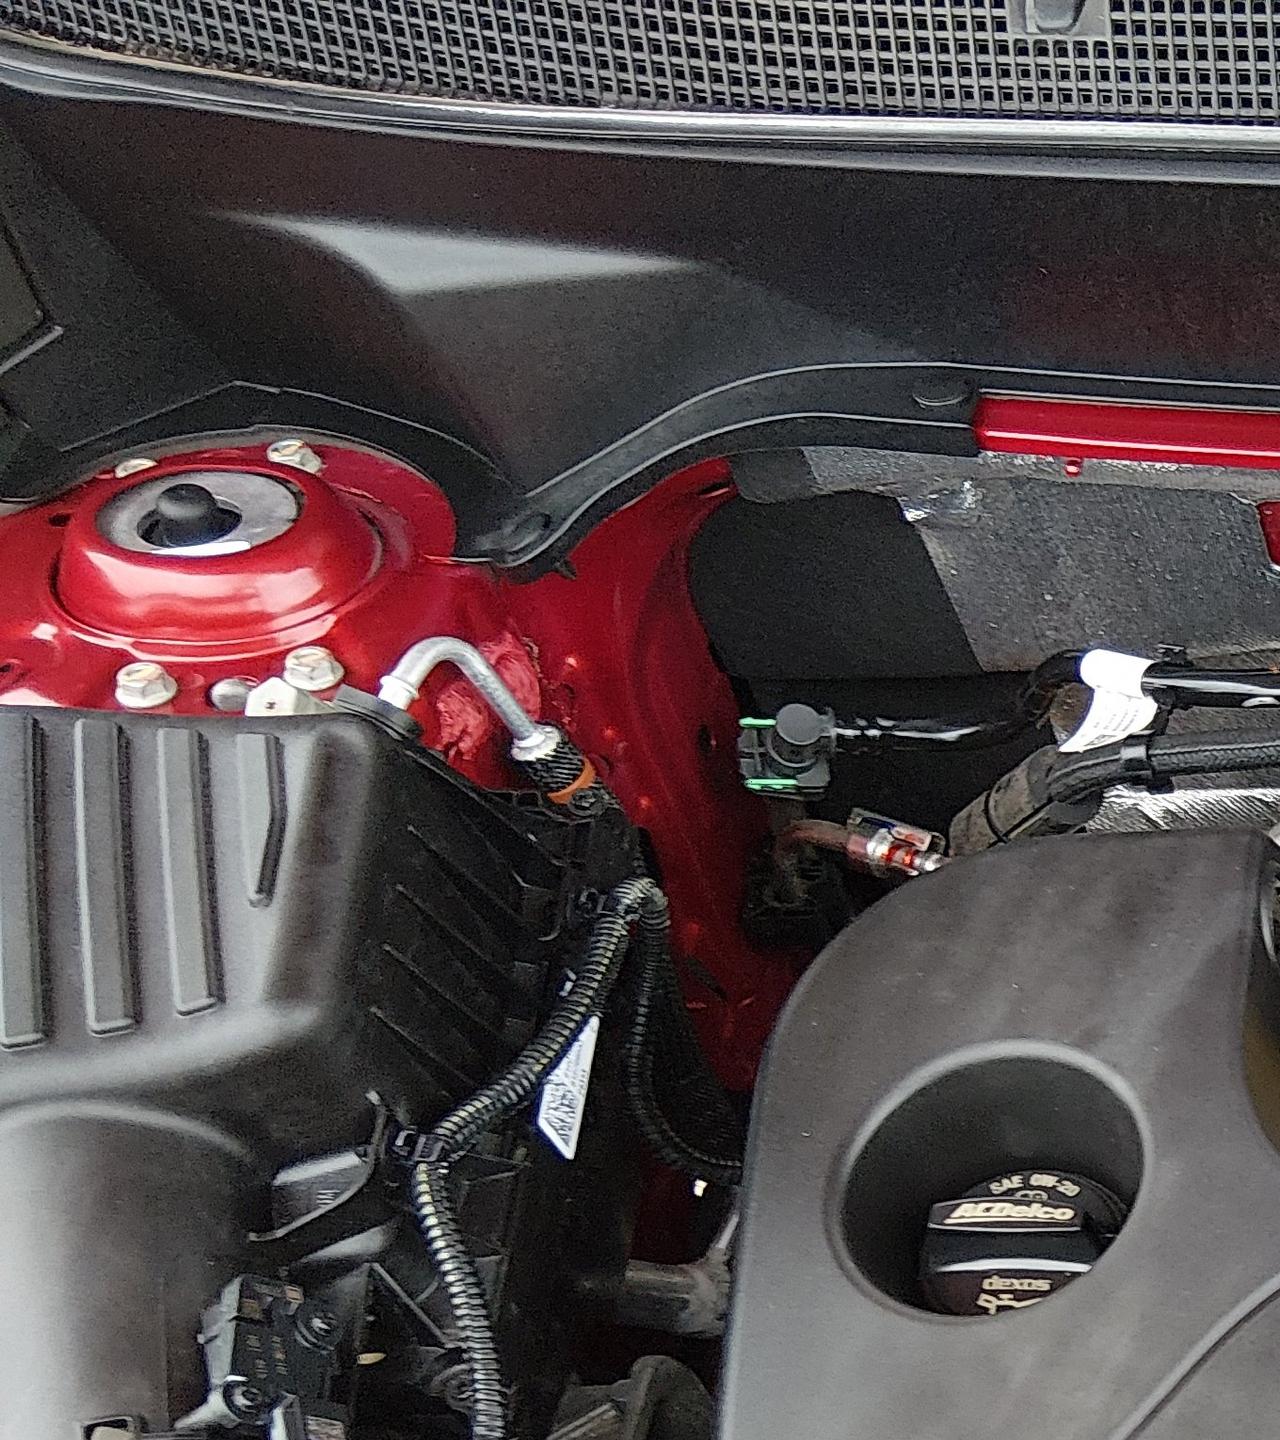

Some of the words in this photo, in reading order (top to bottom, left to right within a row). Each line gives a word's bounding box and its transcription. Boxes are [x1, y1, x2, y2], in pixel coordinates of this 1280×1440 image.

[989, 1174, 1025, 1195] SAE
[949, 1201, 1076, 1222] ACDelco
[982, 1274, 1055, 1291] dexos
